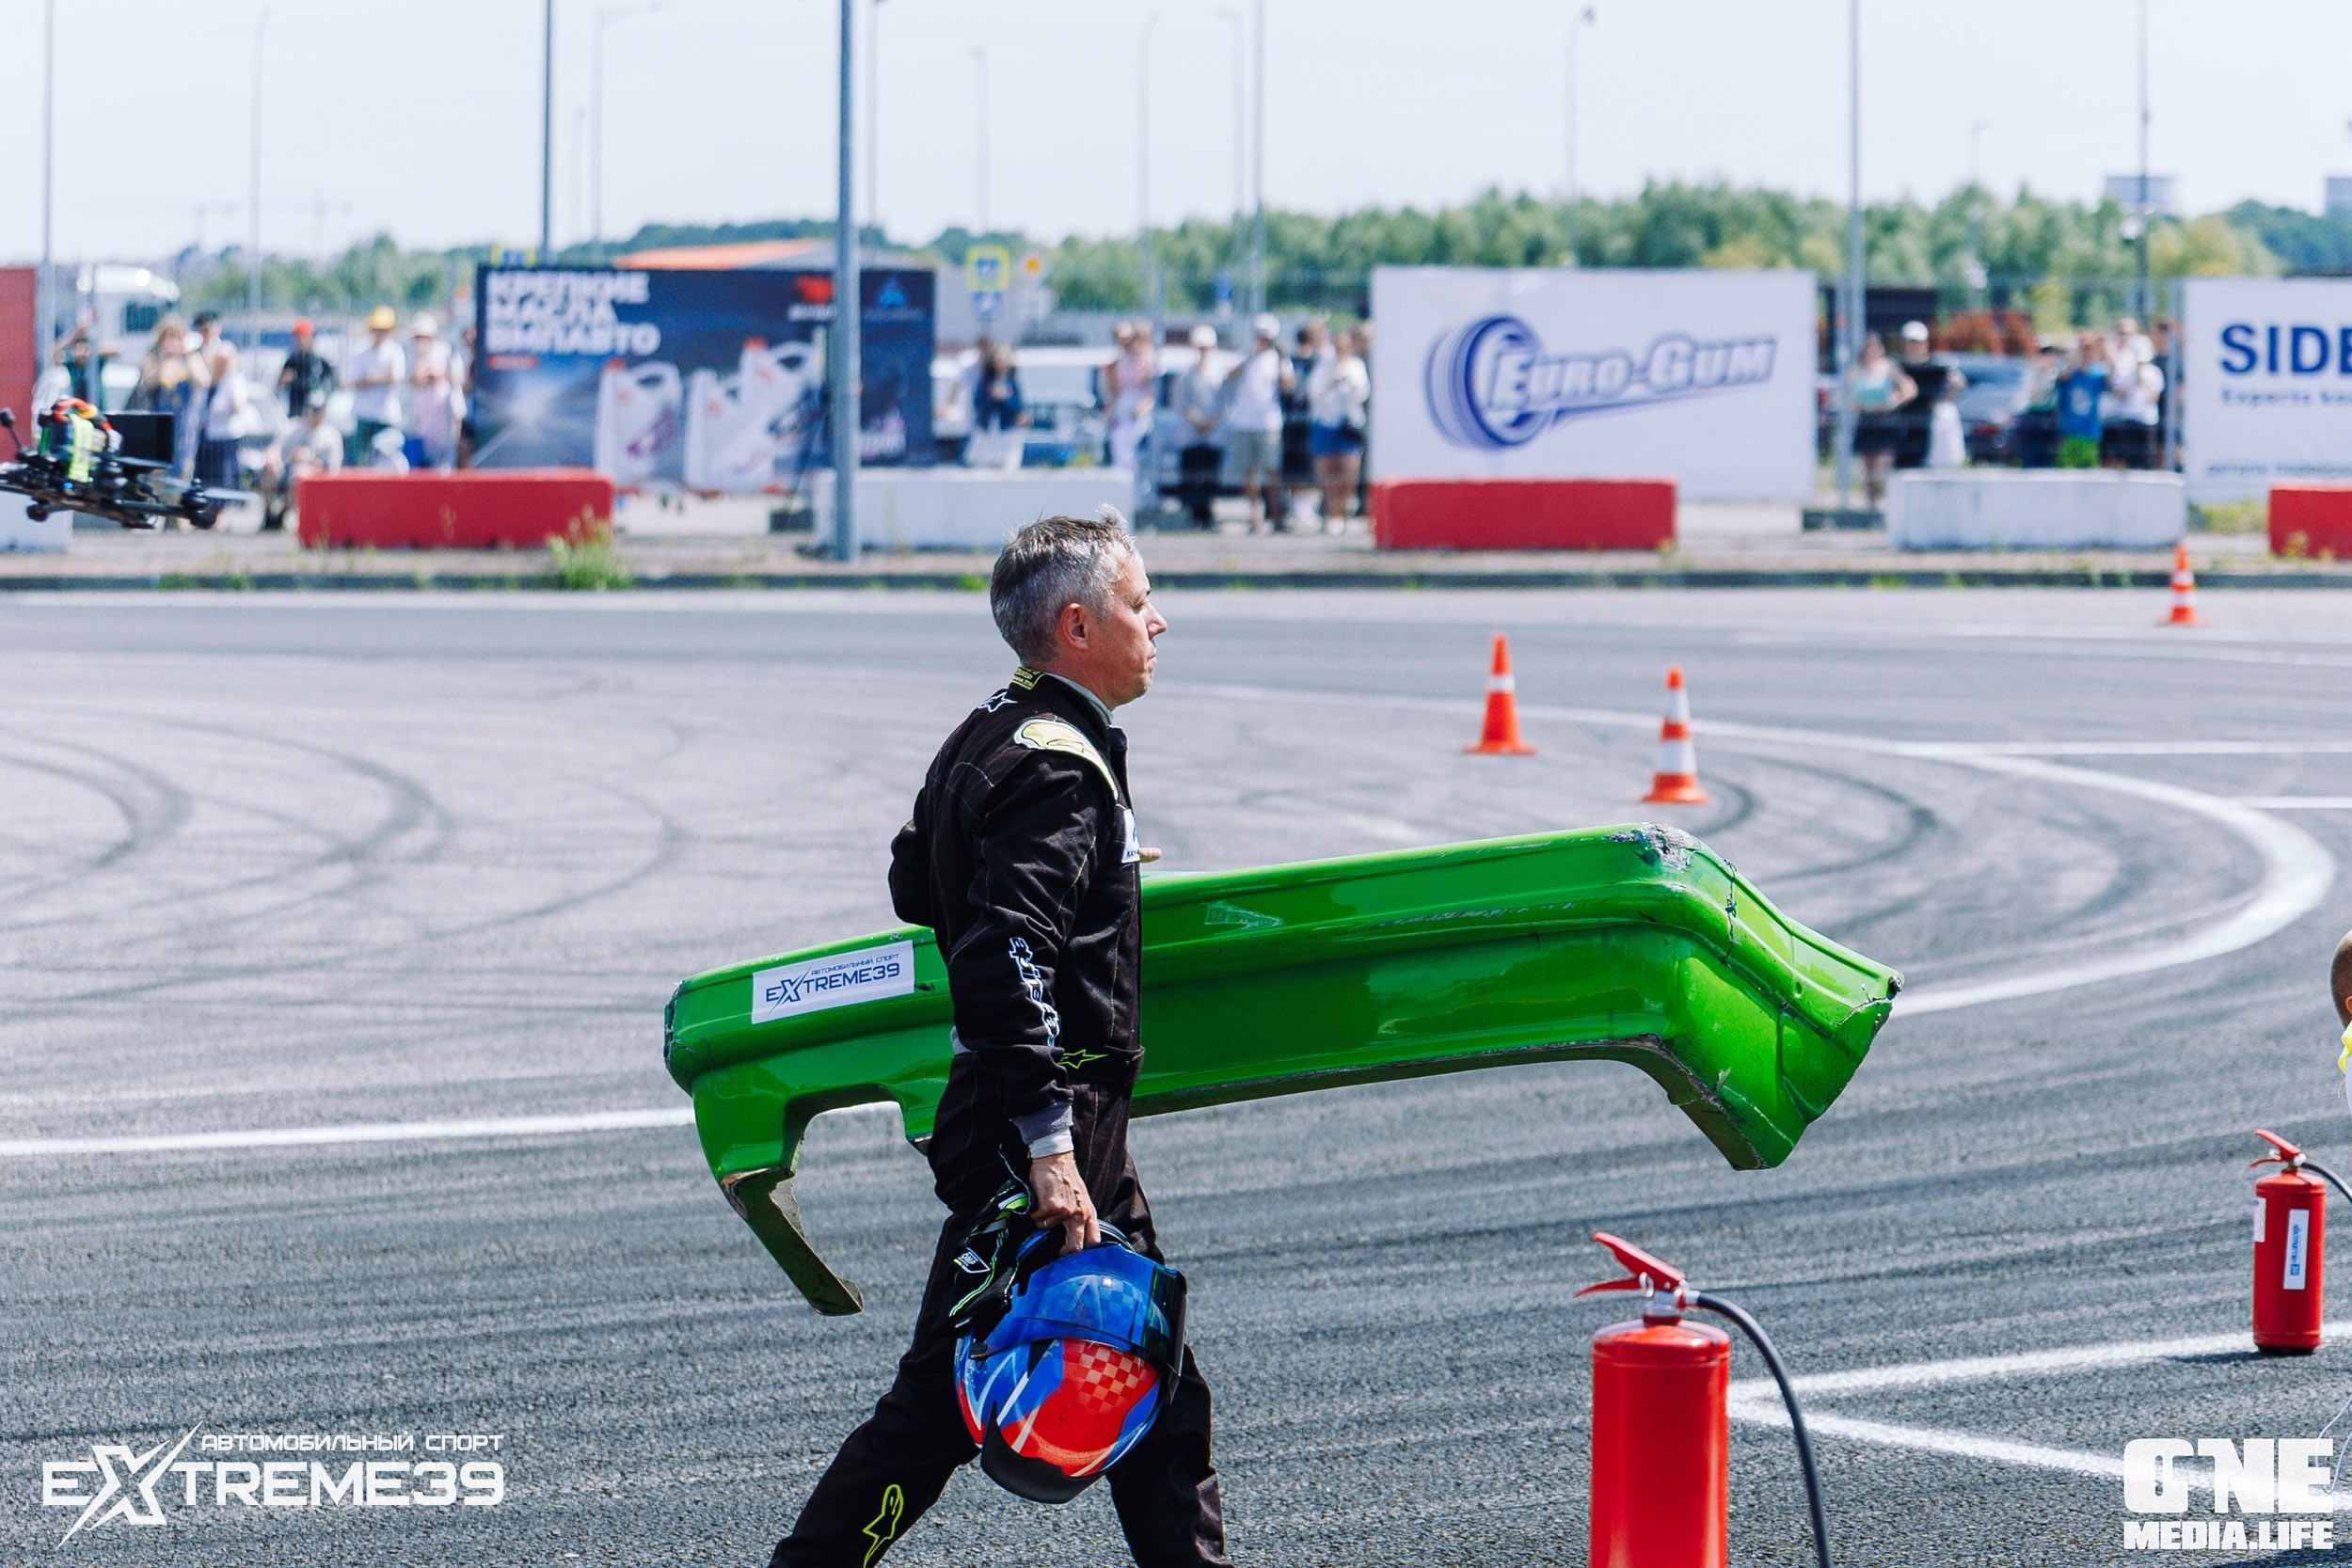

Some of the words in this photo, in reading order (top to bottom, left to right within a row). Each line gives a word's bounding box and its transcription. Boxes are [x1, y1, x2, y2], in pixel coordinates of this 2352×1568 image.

[486, 271, 650, 302] КРЕПКИЕ
[486, 297, 619, 326] МАСЛА
[876, 953, 900, 963] СПОРТ
